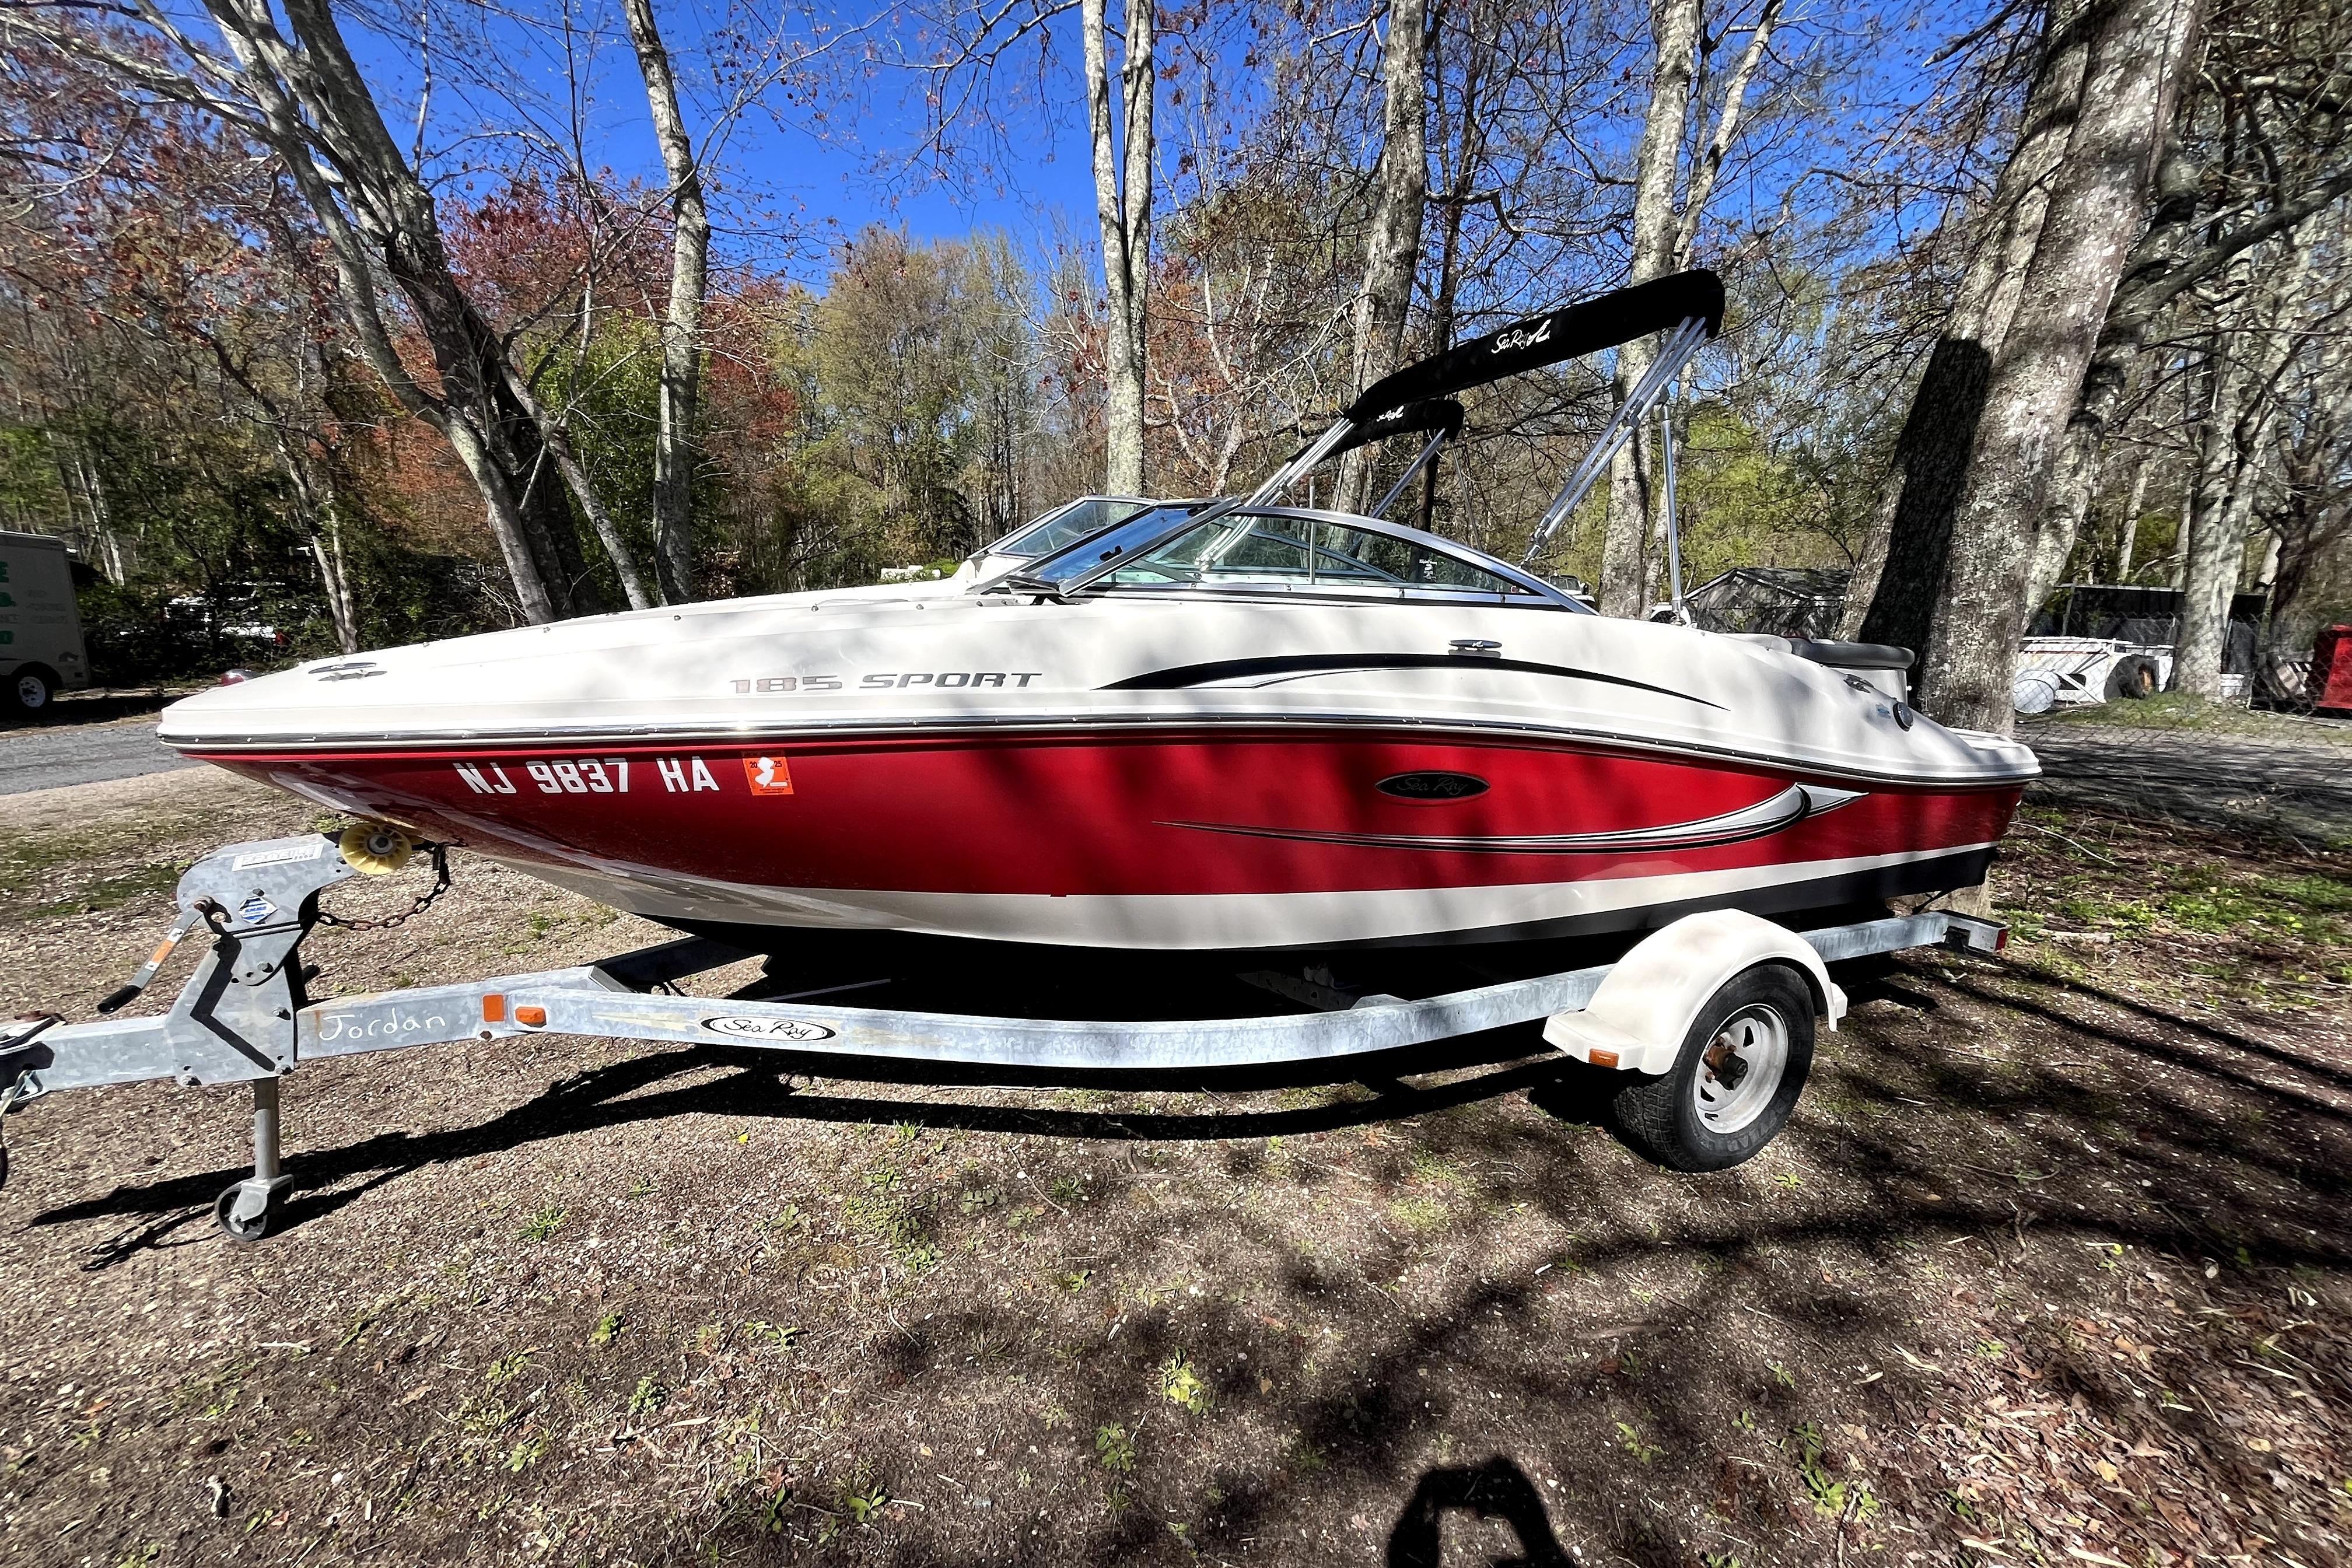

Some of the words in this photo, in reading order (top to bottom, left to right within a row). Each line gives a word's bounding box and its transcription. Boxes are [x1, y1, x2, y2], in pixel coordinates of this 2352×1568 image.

[729, 675, 842, 694] 185
[859, 673, 1042, 688] SPORT
[452, 762, 517, 793] NJ
[526, 758, 629, 793] 9837
[656, 755, 720, 793] HA
[1396, 778, 1429, 791] Sea
[1433, 777, 1468, 796] Ray
[318, 1007, 446, 1041] Jordan
[723, 1019, 766, 1032] Sea
[769, 1021, 813, 1040] Ray
